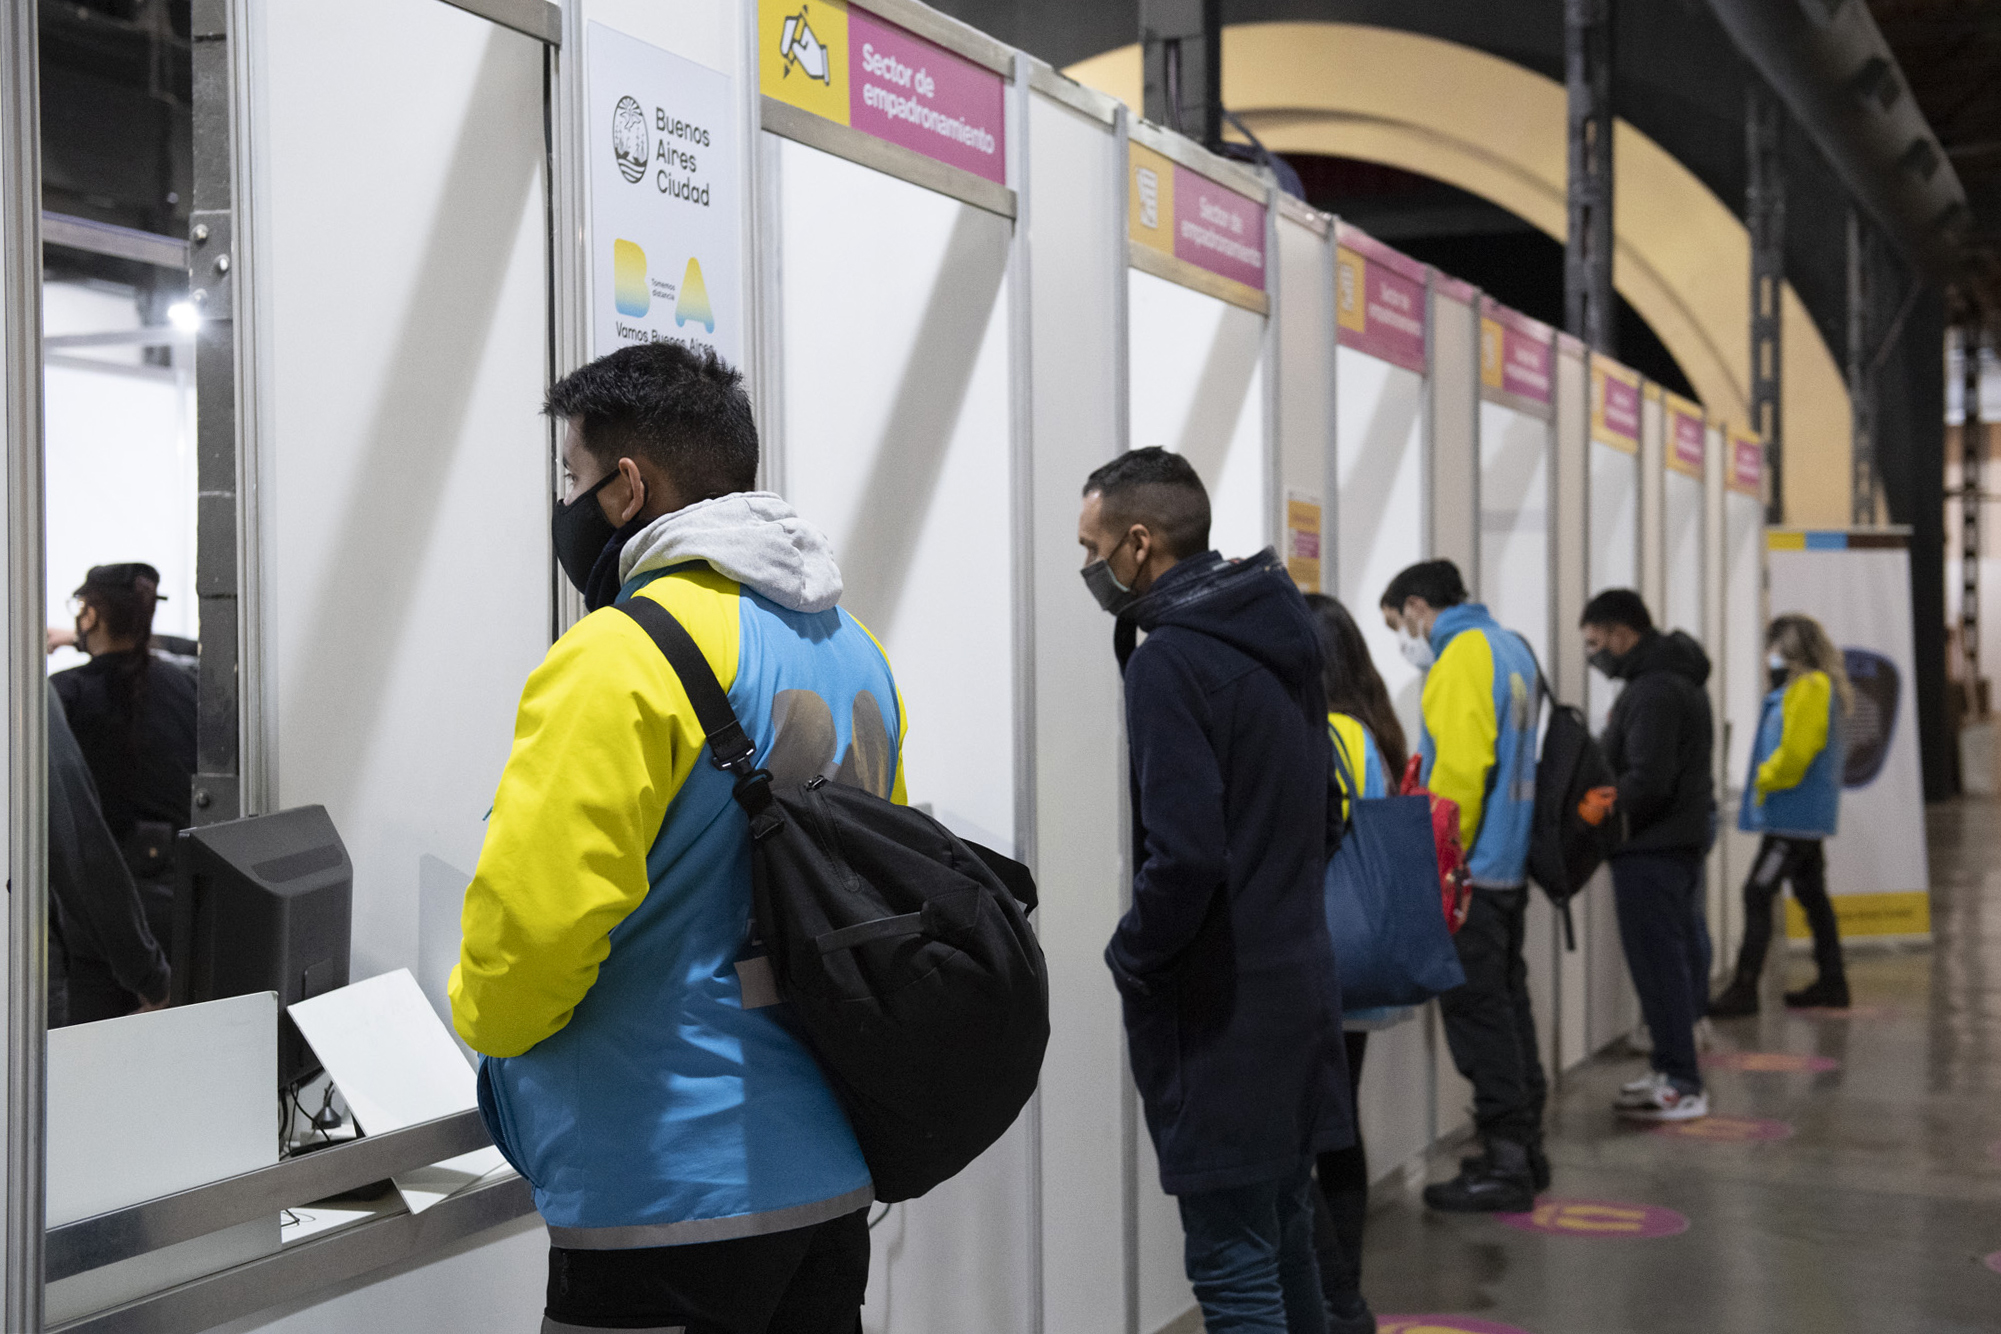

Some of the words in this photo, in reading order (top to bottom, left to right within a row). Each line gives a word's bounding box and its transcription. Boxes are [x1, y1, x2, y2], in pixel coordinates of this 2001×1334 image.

[862, 42, 913, 89] Sector
[914, 67, 935, 99] de
[656, 106, 710, 147] Buenos
[862, 83, 995, 154] empadronamiento
[656, 138, 697, 173] Aires
[656, 168, 710, 208] Ciudad
[615, 321, 649, 343] Vamos
